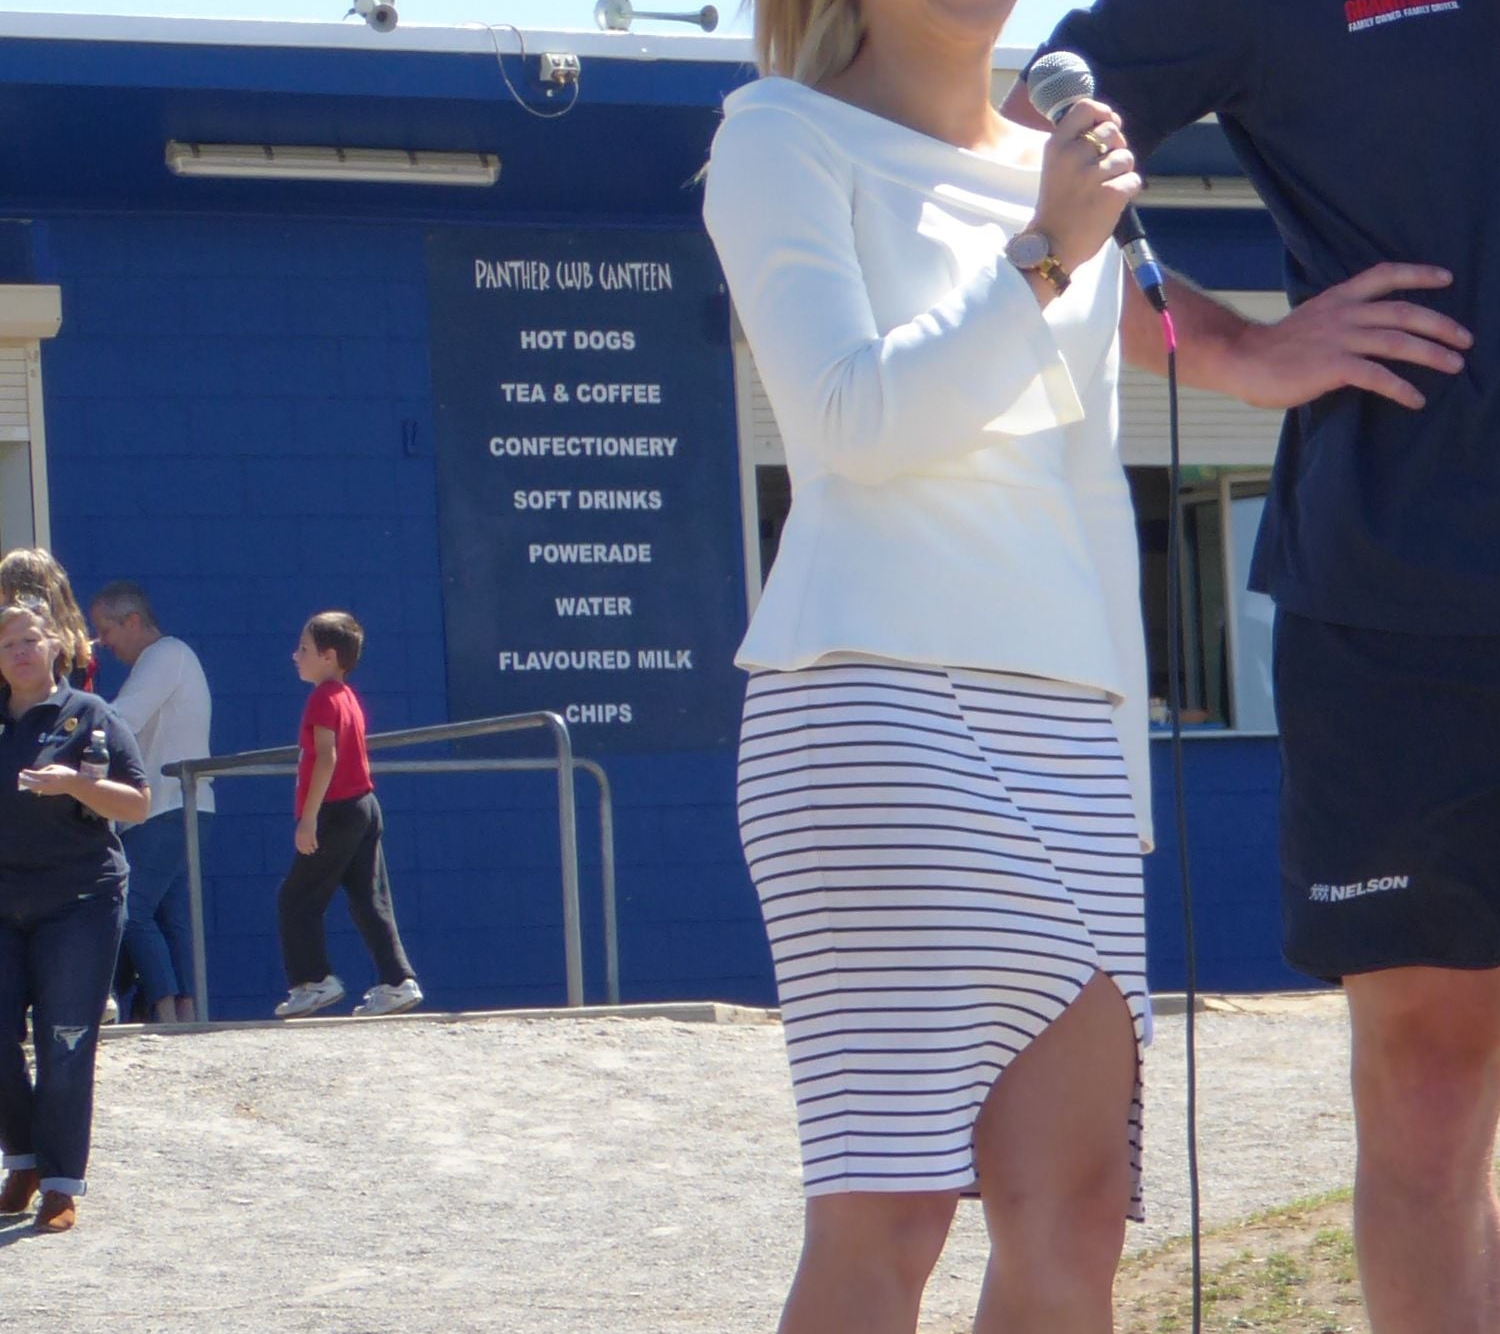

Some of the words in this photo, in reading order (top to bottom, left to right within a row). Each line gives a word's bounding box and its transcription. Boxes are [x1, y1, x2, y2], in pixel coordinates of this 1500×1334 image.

[475, 259, 549, 291] PANTHER
[556, 261, 593, 291] CLUB
[599, 261, 672, 292] CANTEEN
[520, 331, 566, 350] HOT
[574, 331, 636, 350] DOGS
[501, 384, 546, 403] TEA
[553, 384, 569, 403] &
[576, 384, 661, 404] COFFEE
[489, 437, 678, 457] CONFECTIONERY
[513, 491, 571, 510] SOFT
[578, 491, 662, 510] DRINKS
[529, 544, 652, 563] POWERADE
[555, 597, 632, 616] WATER
[499, 650, 631, 671] FLAVOURED
[637, 650, 692, 669] MILK
[565, 704, 632, 723] CHIPS
[1330, 875, 1408, 902] NELSON
